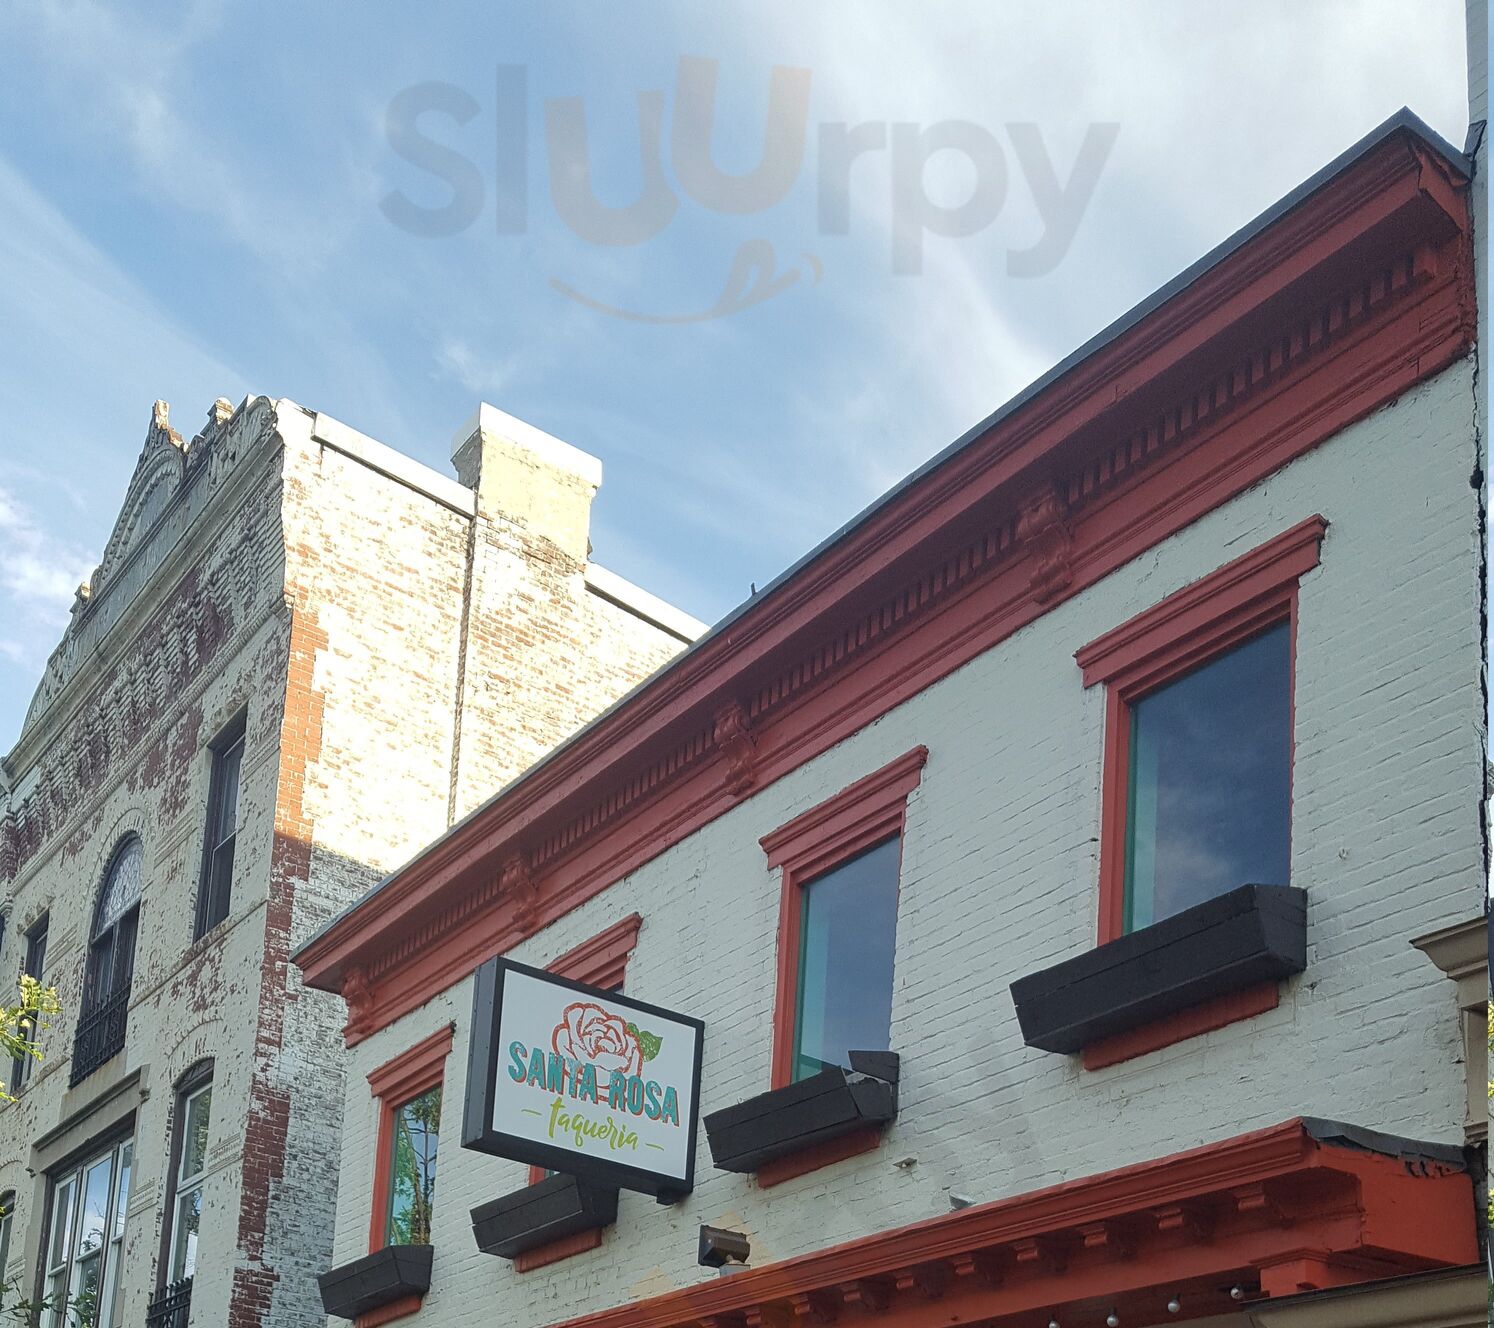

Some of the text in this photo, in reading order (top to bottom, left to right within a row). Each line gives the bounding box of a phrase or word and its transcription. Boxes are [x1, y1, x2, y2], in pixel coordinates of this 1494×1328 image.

[507, 1040, 680, 1127] SANTA ROSA
[549, 1096, 639, 1151] taqueria
